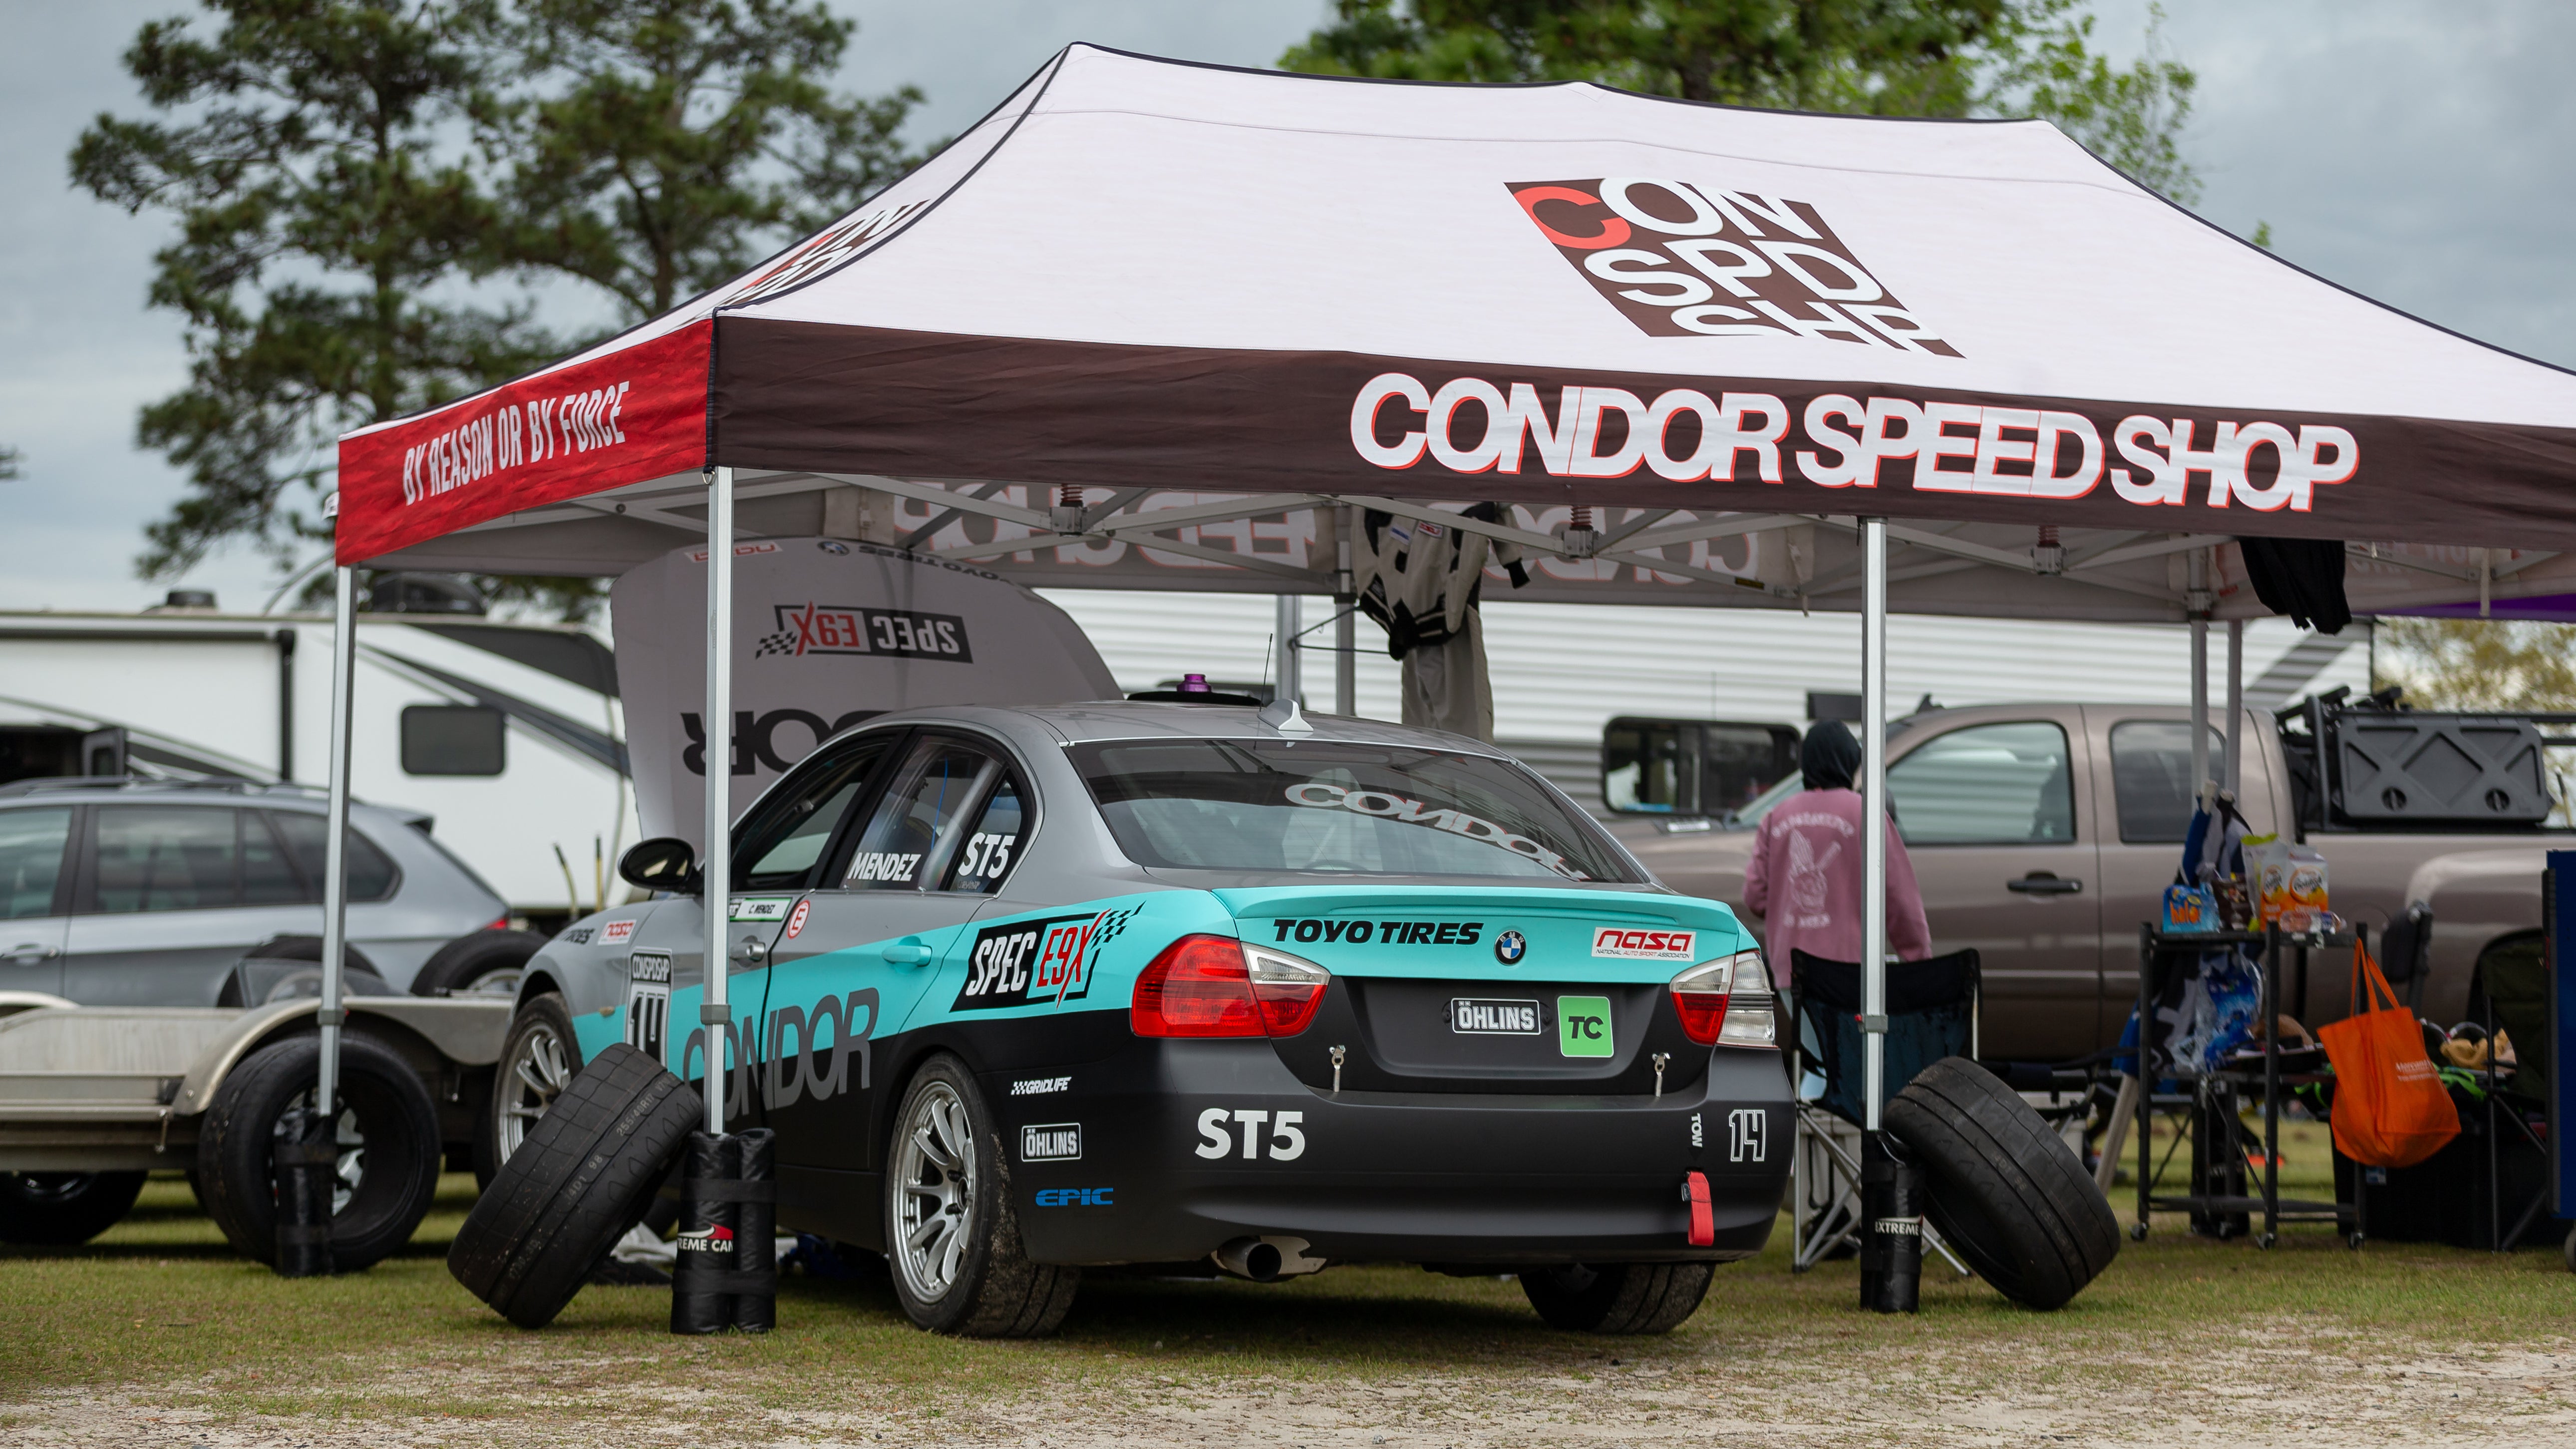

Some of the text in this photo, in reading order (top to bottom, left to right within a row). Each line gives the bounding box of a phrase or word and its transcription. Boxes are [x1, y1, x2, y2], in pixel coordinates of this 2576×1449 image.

[1513, 178, 1824, 249] CON
[1584, 237, 1883, 307] SPD
[403, 380, 630, 506] BY REASON OR BY FORCE
[1350, 372, 2360, 512] CONDOR SPEED SHOP
[791, 600, 961, 657] SPEC E9X
[847, 852, 922, 882] MENDEZ
[958, 832, 1016, 878] ST5
[792, 908, 806, 930] E
[1273, 918, 1485, 945] TOYO TIRES
[1499, 931, 1525, 943] BMW
[966, 908, 1112, 1011] SPEC E9X
[1458, 1000, 1535, 1030] ÖHLINS
[1568, 1015, 1604, 1040] TC
[1025, 1076, 1072, 1095] GRIDLIFE
[1025, 1128, 1077, 1157] ÖHLINS
[1195, 1107, 1306, 1161] ST5
[1691, 1113, 1703, 1148] TOW
[1728, 1109, 1766, 1162] 14
[1035, 1187, 1114, 1206] EPIC
